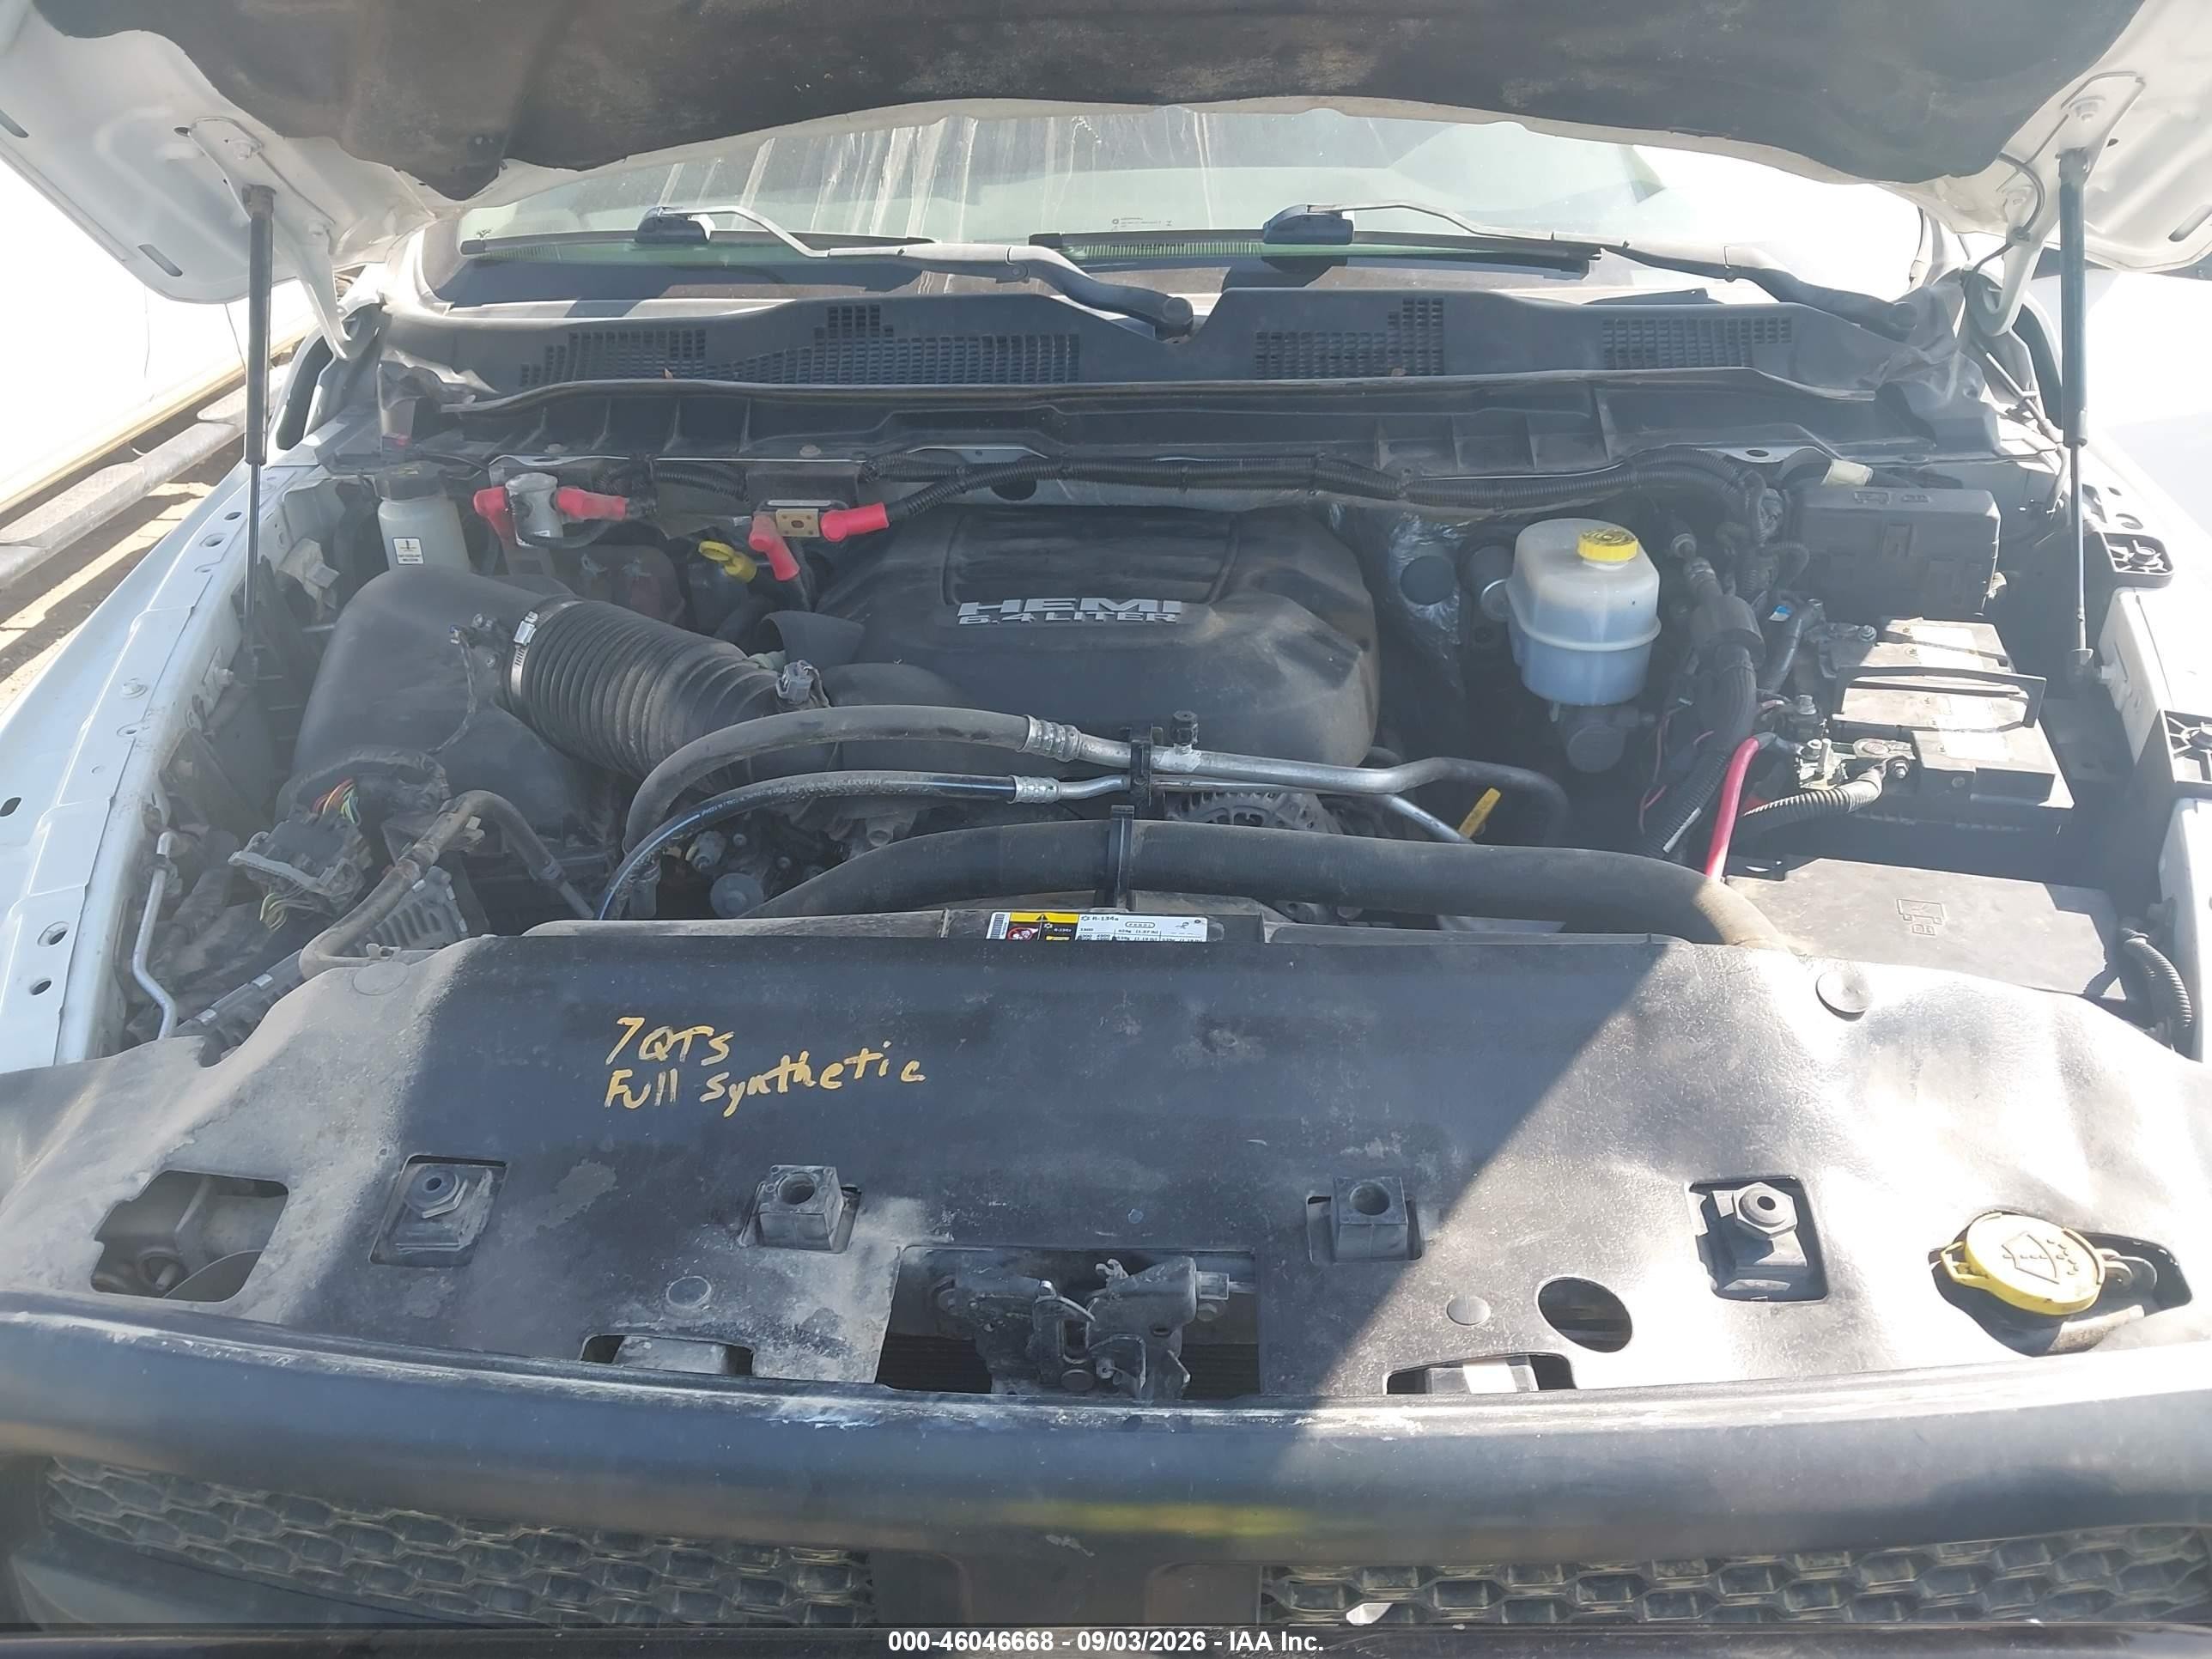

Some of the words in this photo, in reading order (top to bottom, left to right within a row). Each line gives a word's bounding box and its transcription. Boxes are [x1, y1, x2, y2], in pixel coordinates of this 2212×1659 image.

[957, 598, 1182, 617] HEMI
[958, 612, 1036, 625] 6.4
[1045, 611, 1177, 623] LITER
[605, 1068, 678, 1109] Full
